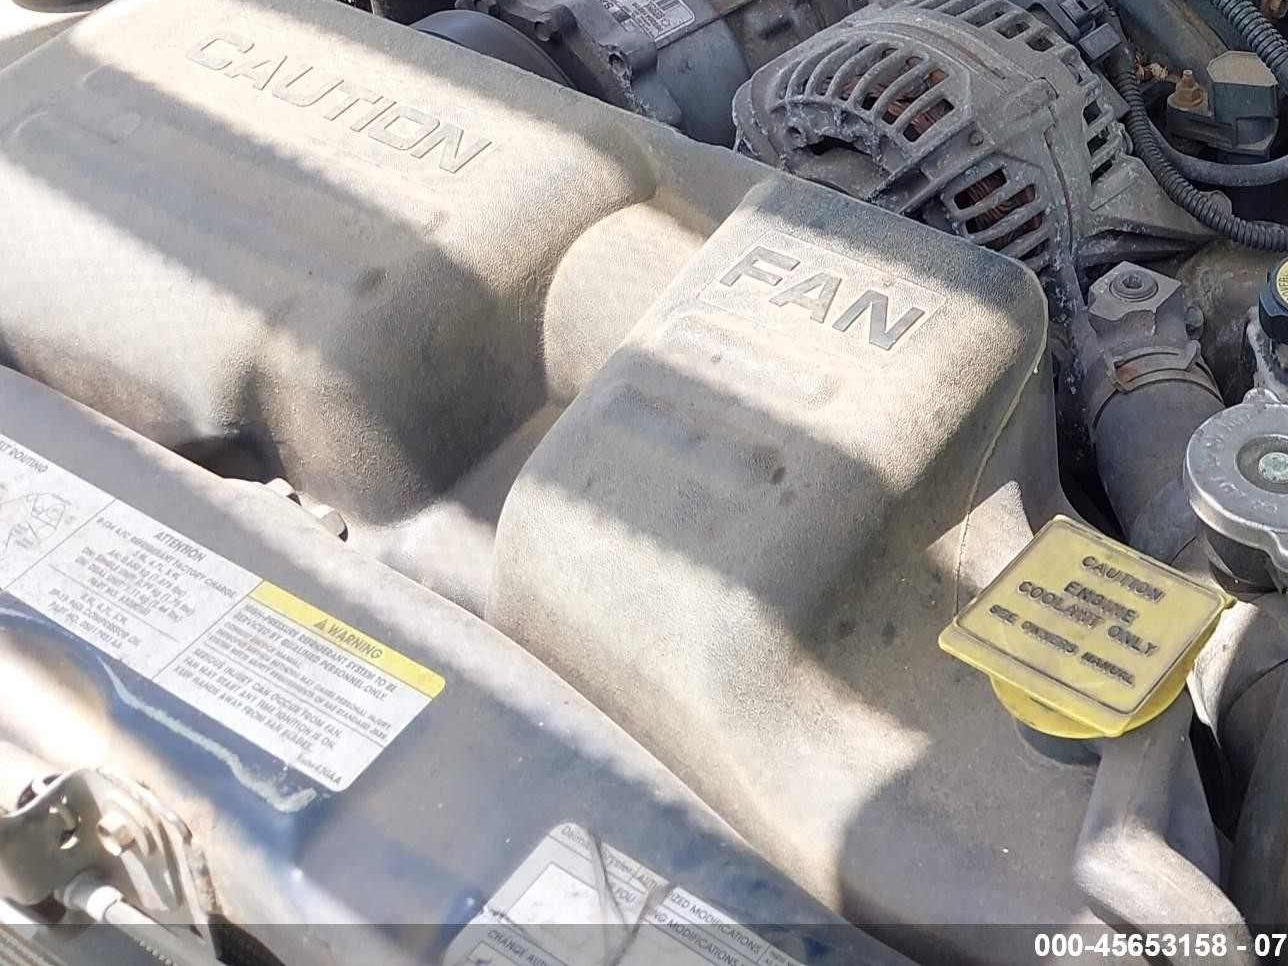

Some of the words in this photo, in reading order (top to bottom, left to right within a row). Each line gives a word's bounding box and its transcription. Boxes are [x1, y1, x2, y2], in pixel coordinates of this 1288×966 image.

[186, 34, 493, 174] CAUTION
[720, 245, 925, 351] FAN
[152, 528, 207, 563] ATTENTION
[1063, 580, 1141, 624] ENGINE
[1081, 555, 1165, 602] CAUTION
[326, 623, 384, 660] WARNING
[988, 603, 1018, 625] SEE
[1021, 621, 1079, 654] OWNERS
[1080, 651, 1136, 686] MANUAL
[1017, 581, 1104, 630] COOLANT
[1107, 625, 1161, 657] ONLY
[232, 611, 271, 636] SERVICED
[268, 631, 282, 642] BY
[279, 637, 321, 664] QUALIFIED
[318, 659, 365, 689] PERSONNEL
[297, 633, 348, 665] REFRIGERANT
[344, 660, 376, 680] SYSTEM
[372, 676, 387, 687] TO
[182, 656, 200, 670] FAN
[197, 665, 218, 680] MAY
[238, 689, 259, 703] ANY
[255, 699, 276, 714] TIME
[273, 709, 314, 735] IGNITION
[311, 731, 322, 740] IS
[192, 648, 226, 670] SERIOUS
[222, 665, 252, 685] INJURY
[250, 681, 272, 696] CAN
[269, 692, 302, 714] OCCUR
[298, 709, 326, 728] FROM
[218, 692, 244, 709] AWAY
[240, 705, 267, 722] FROM
[263, 718, 283, 732] FAN
[485, 928, 527, 957] CHANGE
[666, 918, 741, 966] MODIFICATIONS
[687, 904, 762, 953] MODIFICATIONS
